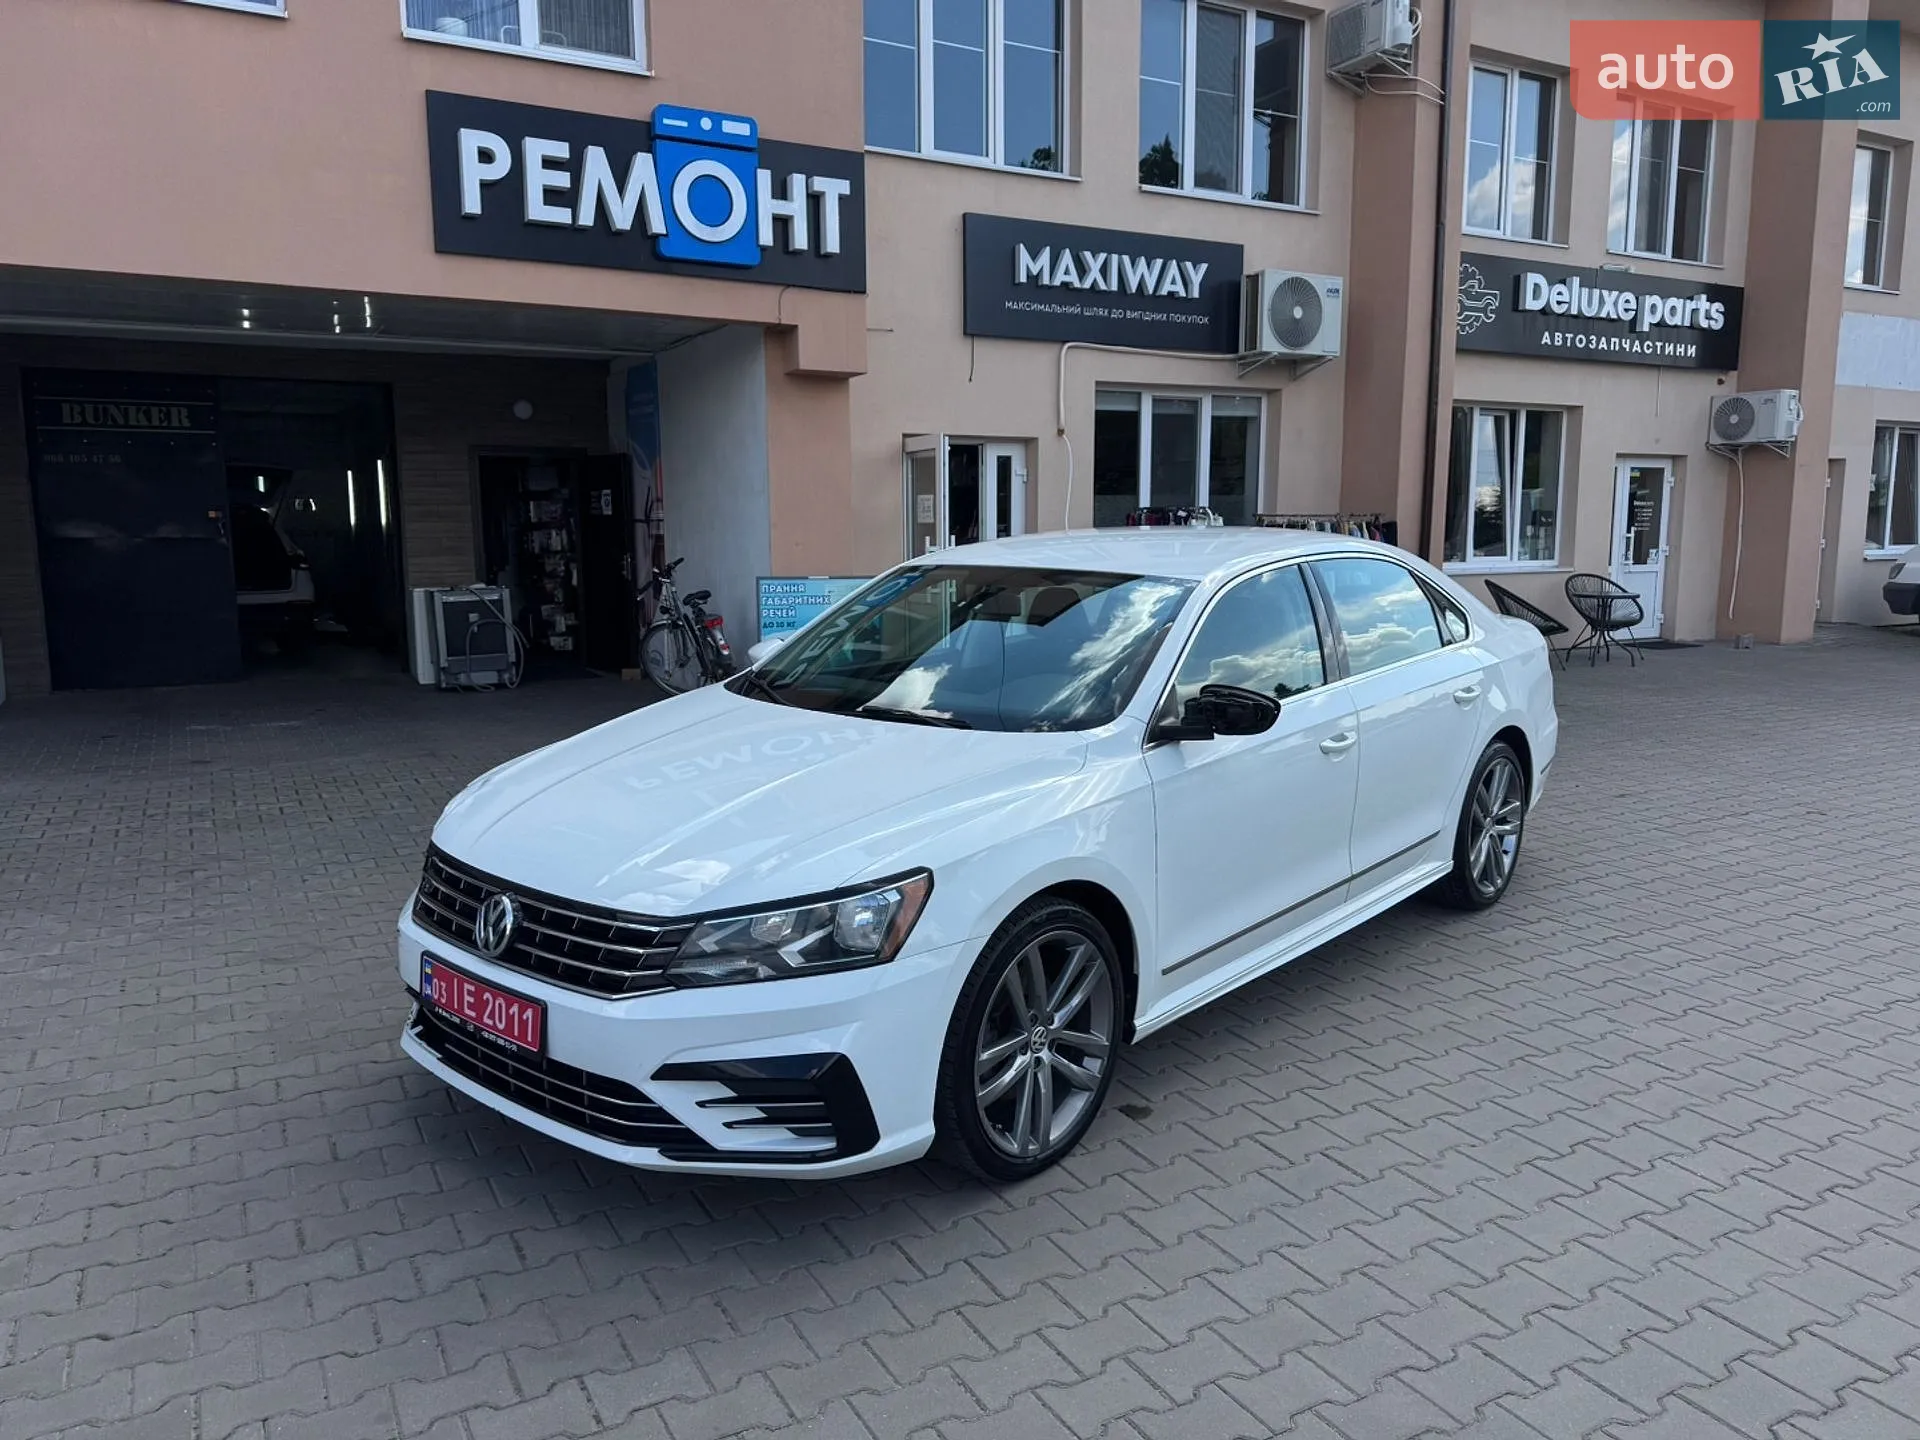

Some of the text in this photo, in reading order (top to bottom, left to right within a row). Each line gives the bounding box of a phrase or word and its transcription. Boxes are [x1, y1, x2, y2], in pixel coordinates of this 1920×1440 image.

[457, 127, 851, 257] РЕМОНТ
[1014, 242, 1208, 299] MAXIWAY
[1005, 300, 1210, 325] МАКСИМАЛЬНИЙ ШЛЯХ ДО ВИГІДНИХ ПОКУПОК
[1518, 271, 1725, 332] Deluxe parts
[1541, 331, 1697, 358] АВТОЗАПЧАСТИНИ
[61, 403, 191, 427] BUNKER
[761, 583, 807, 594] ПРАННЯ
[761, 595, 832, 606] ГАБАРИТНИХ
[761, 606, 797, 618] РЕЧЕЙ
[432, 978, 447, 1004] 03
[483, 991, 534, 1042] 2011
